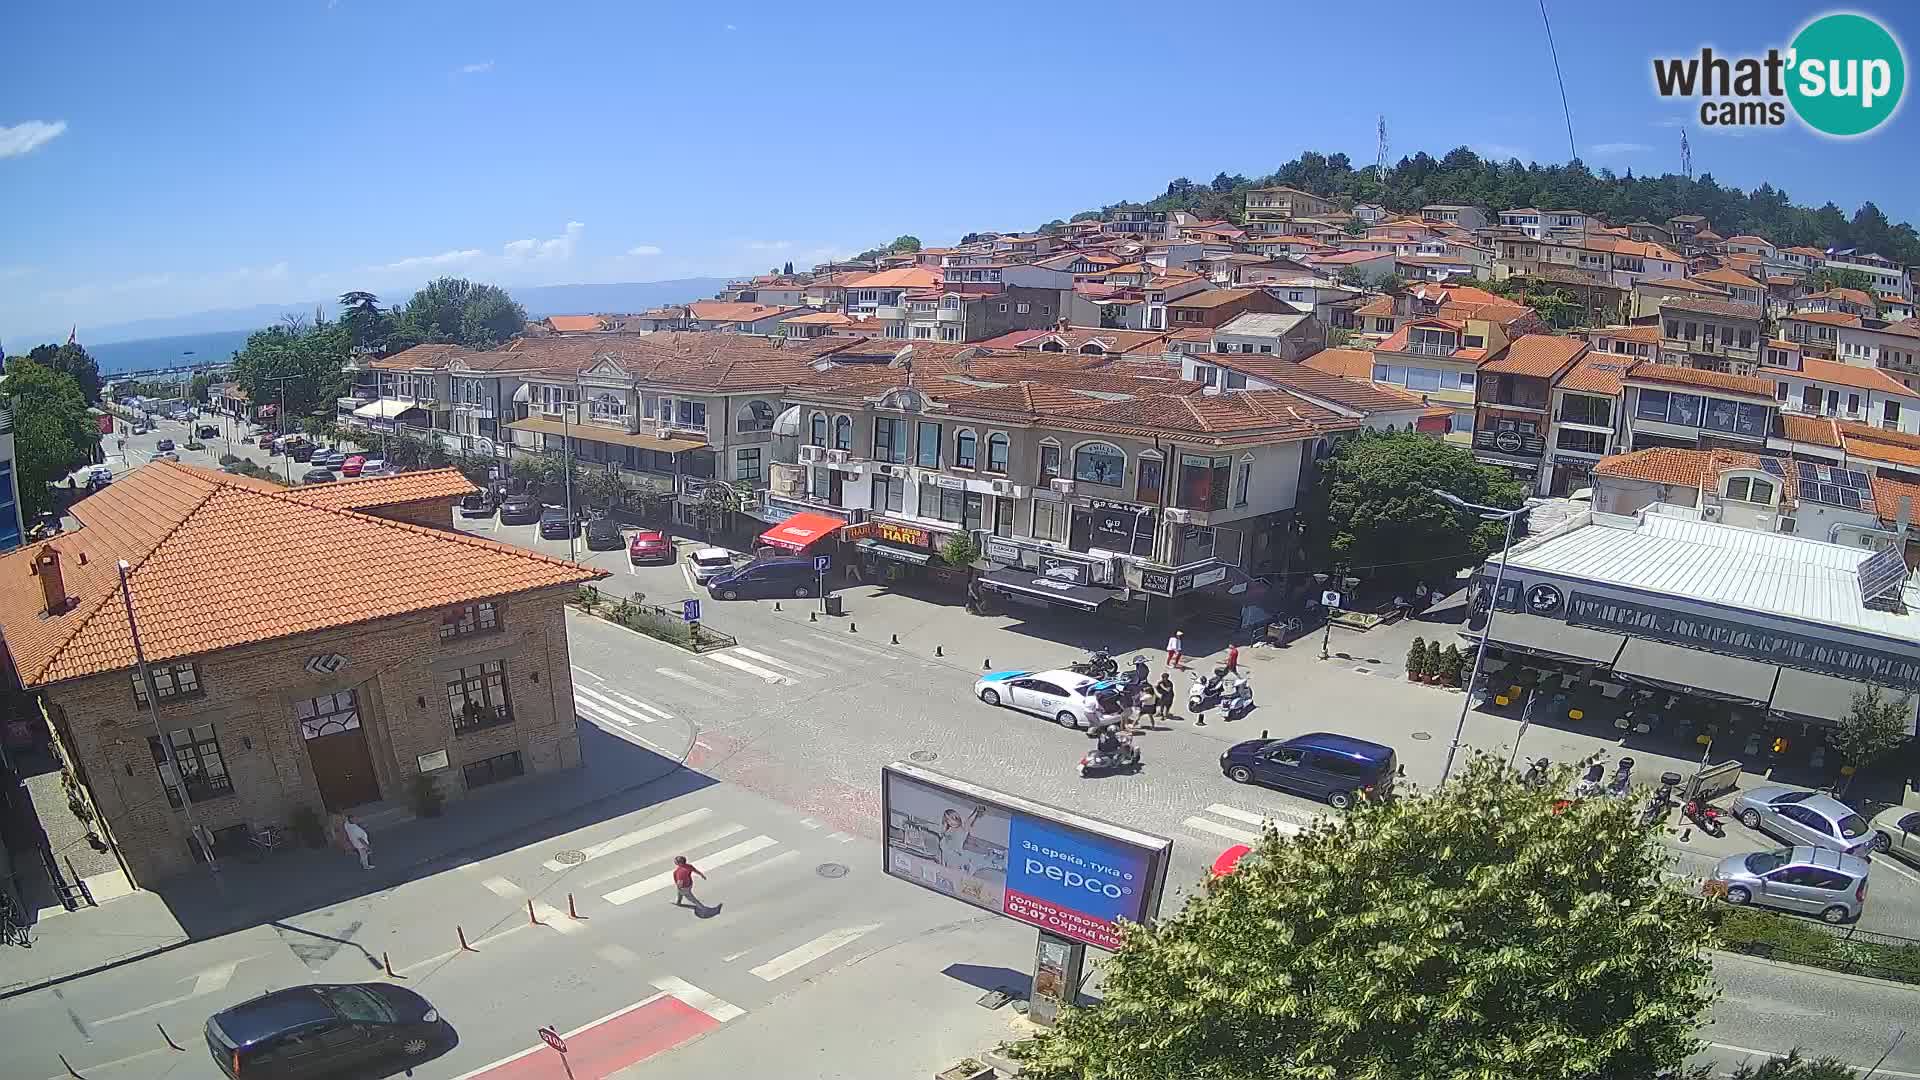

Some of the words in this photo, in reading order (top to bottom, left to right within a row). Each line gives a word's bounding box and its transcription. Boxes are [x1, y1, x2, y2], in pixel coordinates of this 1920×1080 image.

[819, 559, 826, 568] P
[1022, 840, 1039, 852] За
[1090, 861, 1120, 877] тука
[1123, 872, 1133, 880] е
[1025, 858, 1122, 898] pepco
[1009, 902, 1048, 920] 02.07
[1049, 916, 1096, 939] Охрид
[540, 1031, 565, 1050] STOP
